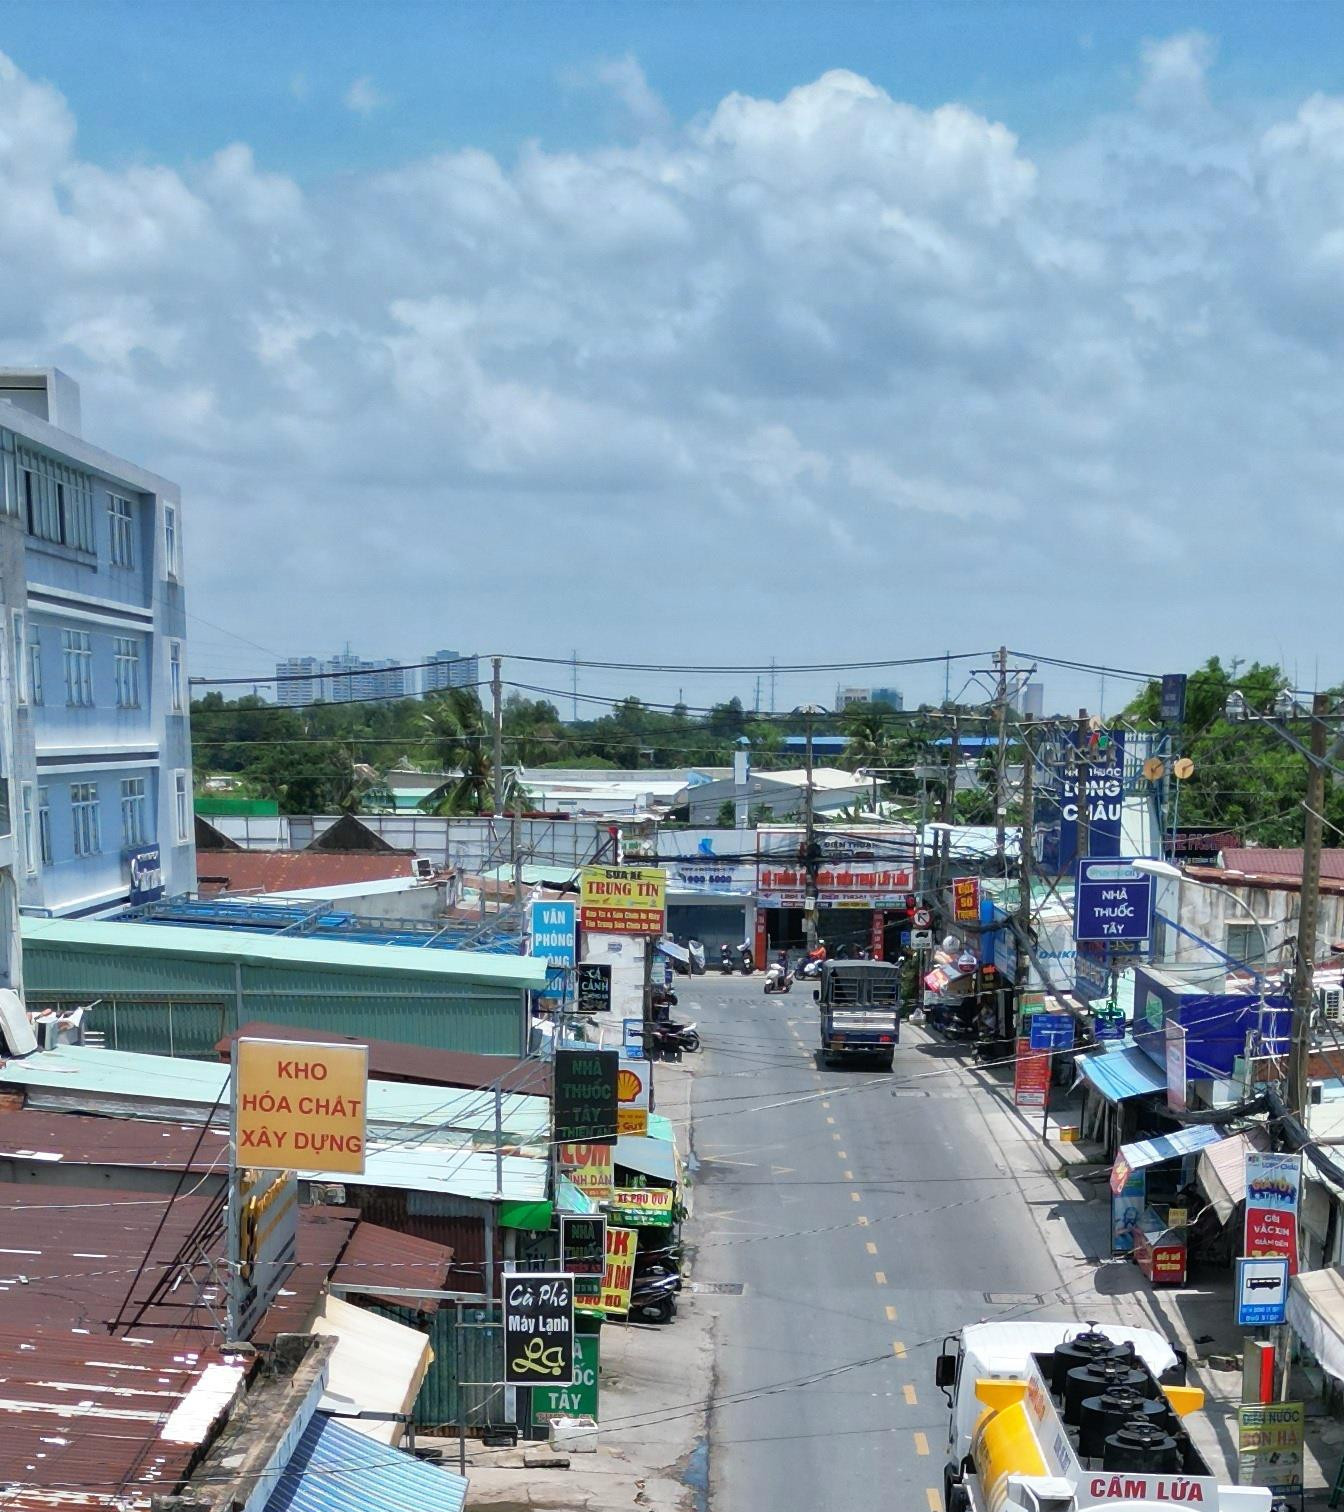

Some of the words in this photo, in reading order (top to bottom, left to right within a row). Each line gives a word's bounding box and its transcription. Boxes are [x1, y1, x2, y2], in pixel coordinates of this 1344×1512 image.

[587, 881, 632, 896] TRUNG
[1093, 902, 1135, 917] THUỐC
[1039, 951, 1076, 959] DAIKI
[277, 1060, 328, 1081] KHO
[242, 1090, 293, 1113] HÓA
[240, 1125, 288, 1148] XÂY
[294, 1131, 362, 1155] DỰNG
[510, 1285, 534, 1306] Cà
[538, 1281, 569, 1307] Phê
[508, 1315, 536, 1335] Máy
[538, 1315, 570, 1336] Lạnh
[548, 1388, 582, 1410] TÂY
[1089, 1475, 1148, 1501] CẤM
[1156, 1477, 1205, 1502] LỬA
